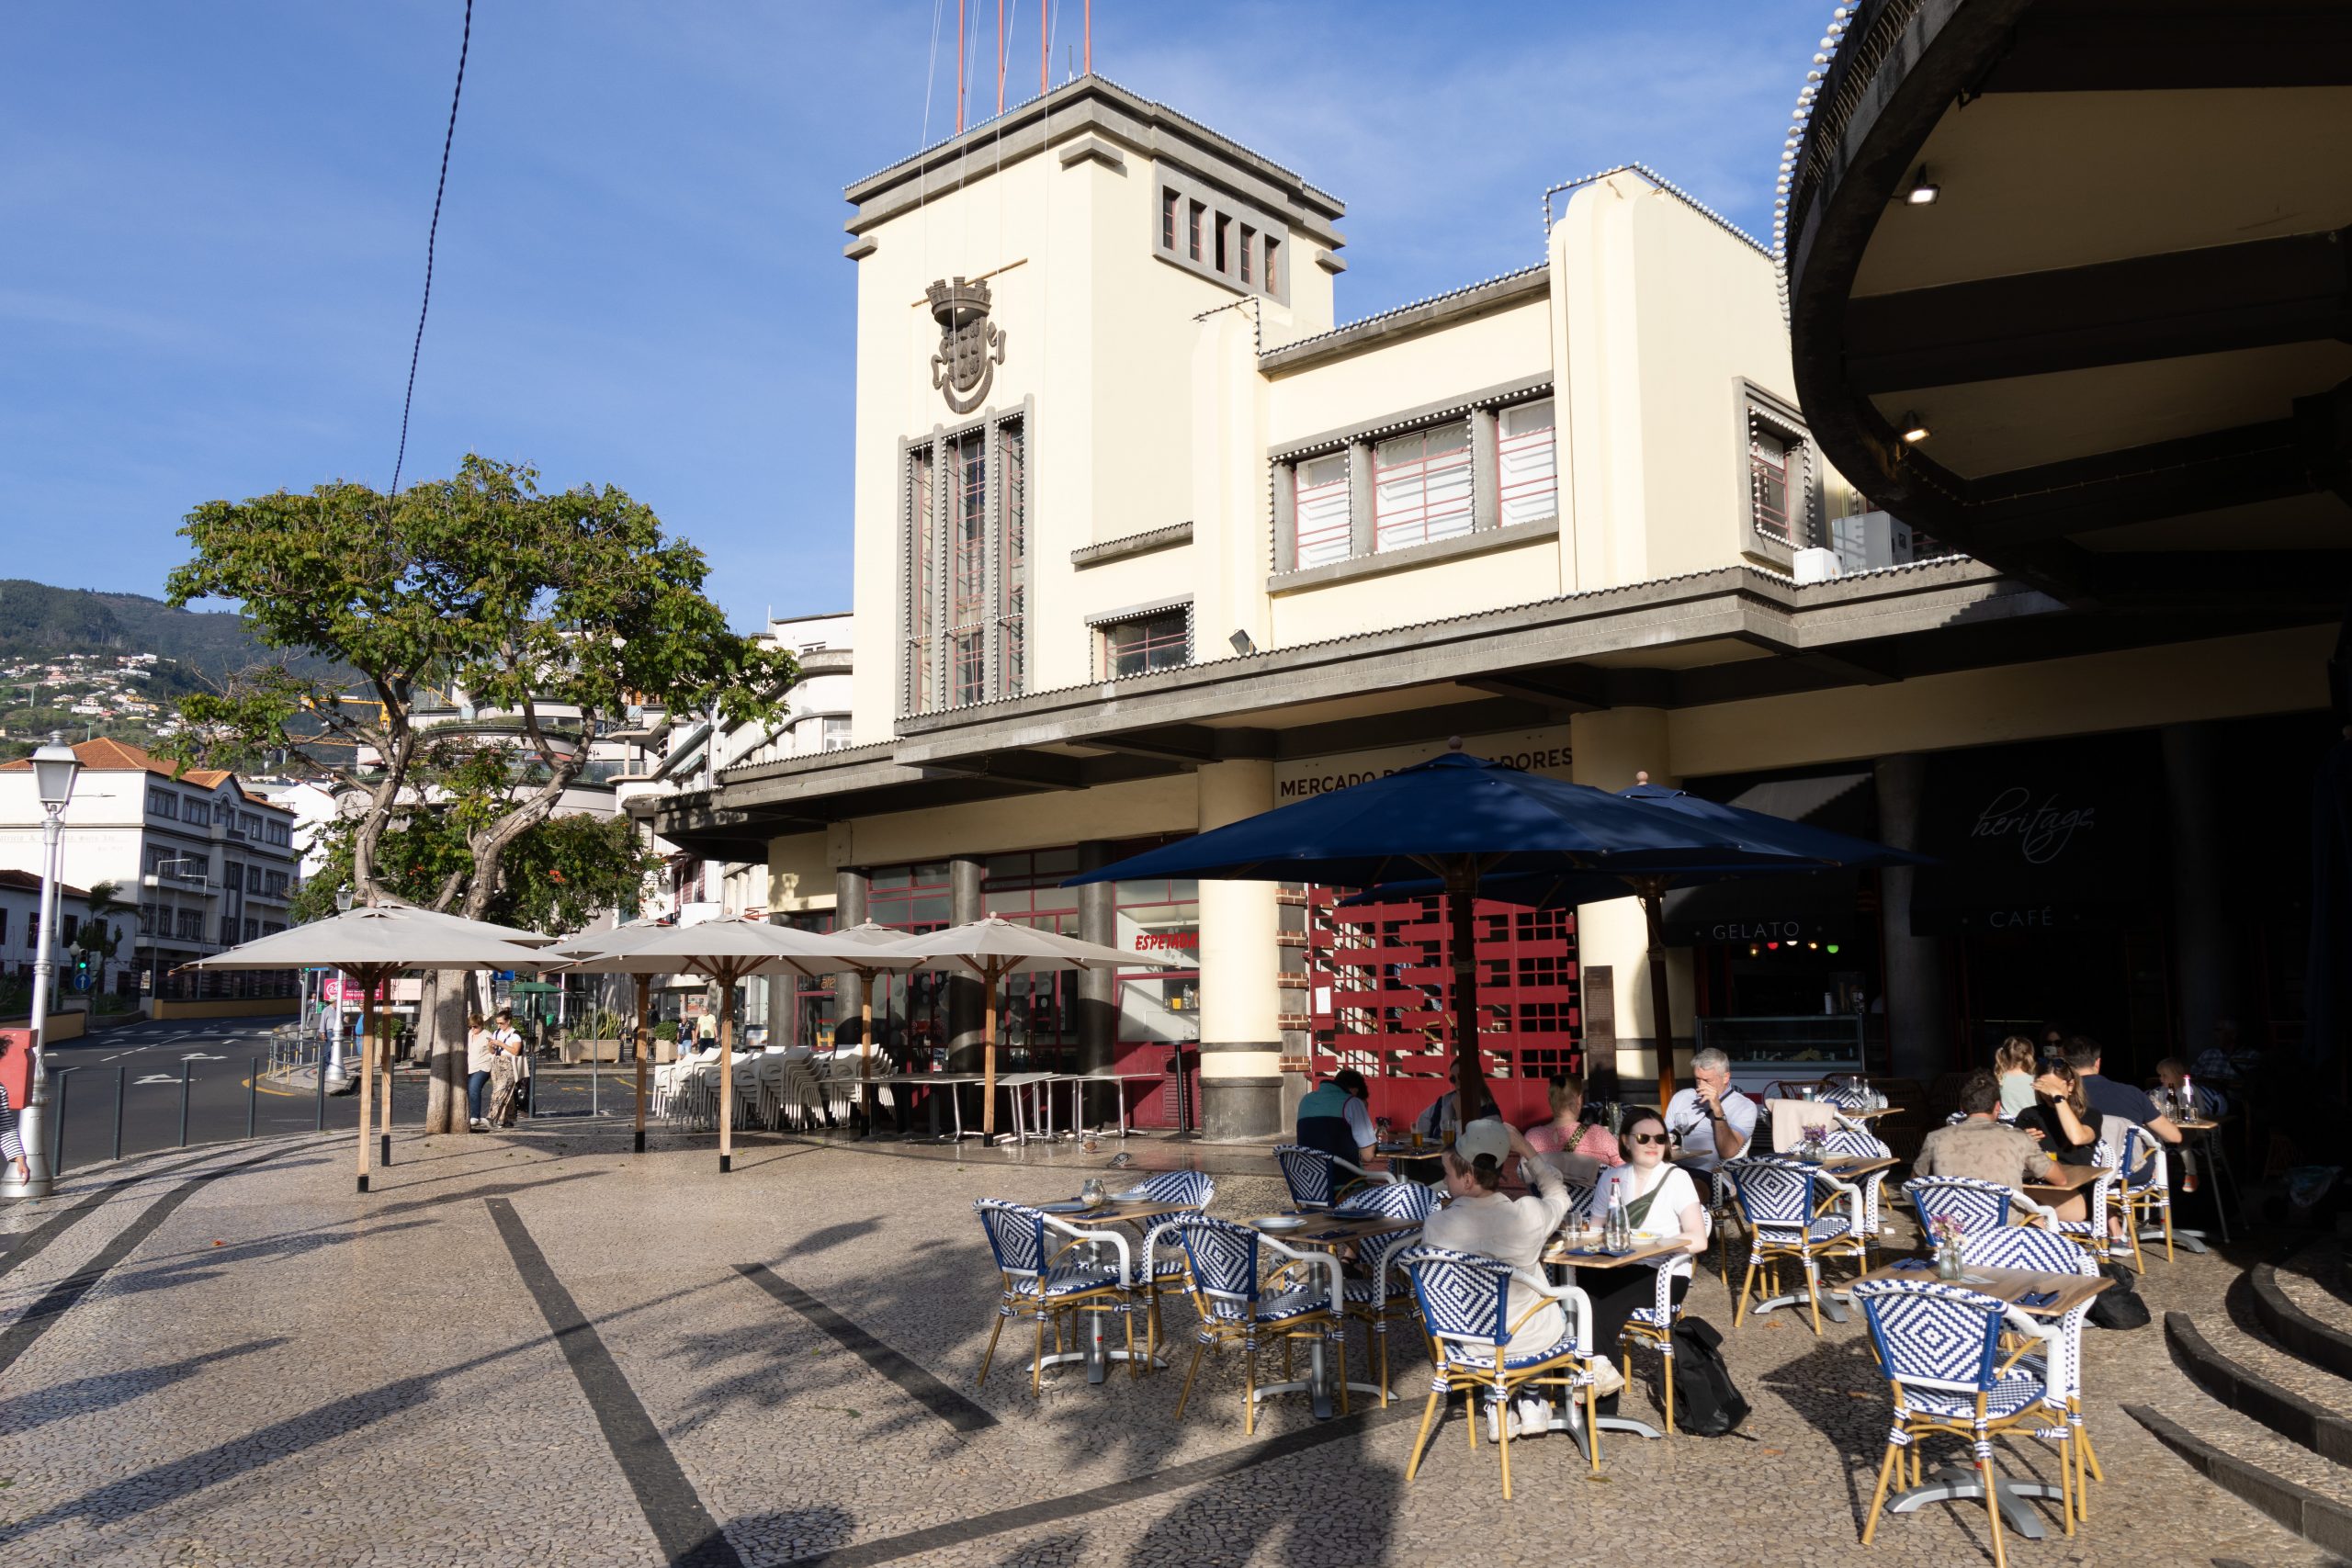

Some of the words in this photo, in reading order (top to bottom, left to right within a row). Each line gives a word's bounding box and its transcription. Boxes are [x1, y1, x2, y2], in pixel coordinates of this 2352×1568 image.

[1280, 771, 1376, 797] MERCADO
[1971, 786, 2096, 864] heritage
[1989, 906, 2053, 928] CAFÉ
[1712, 921, 1800, 940] GELATO
